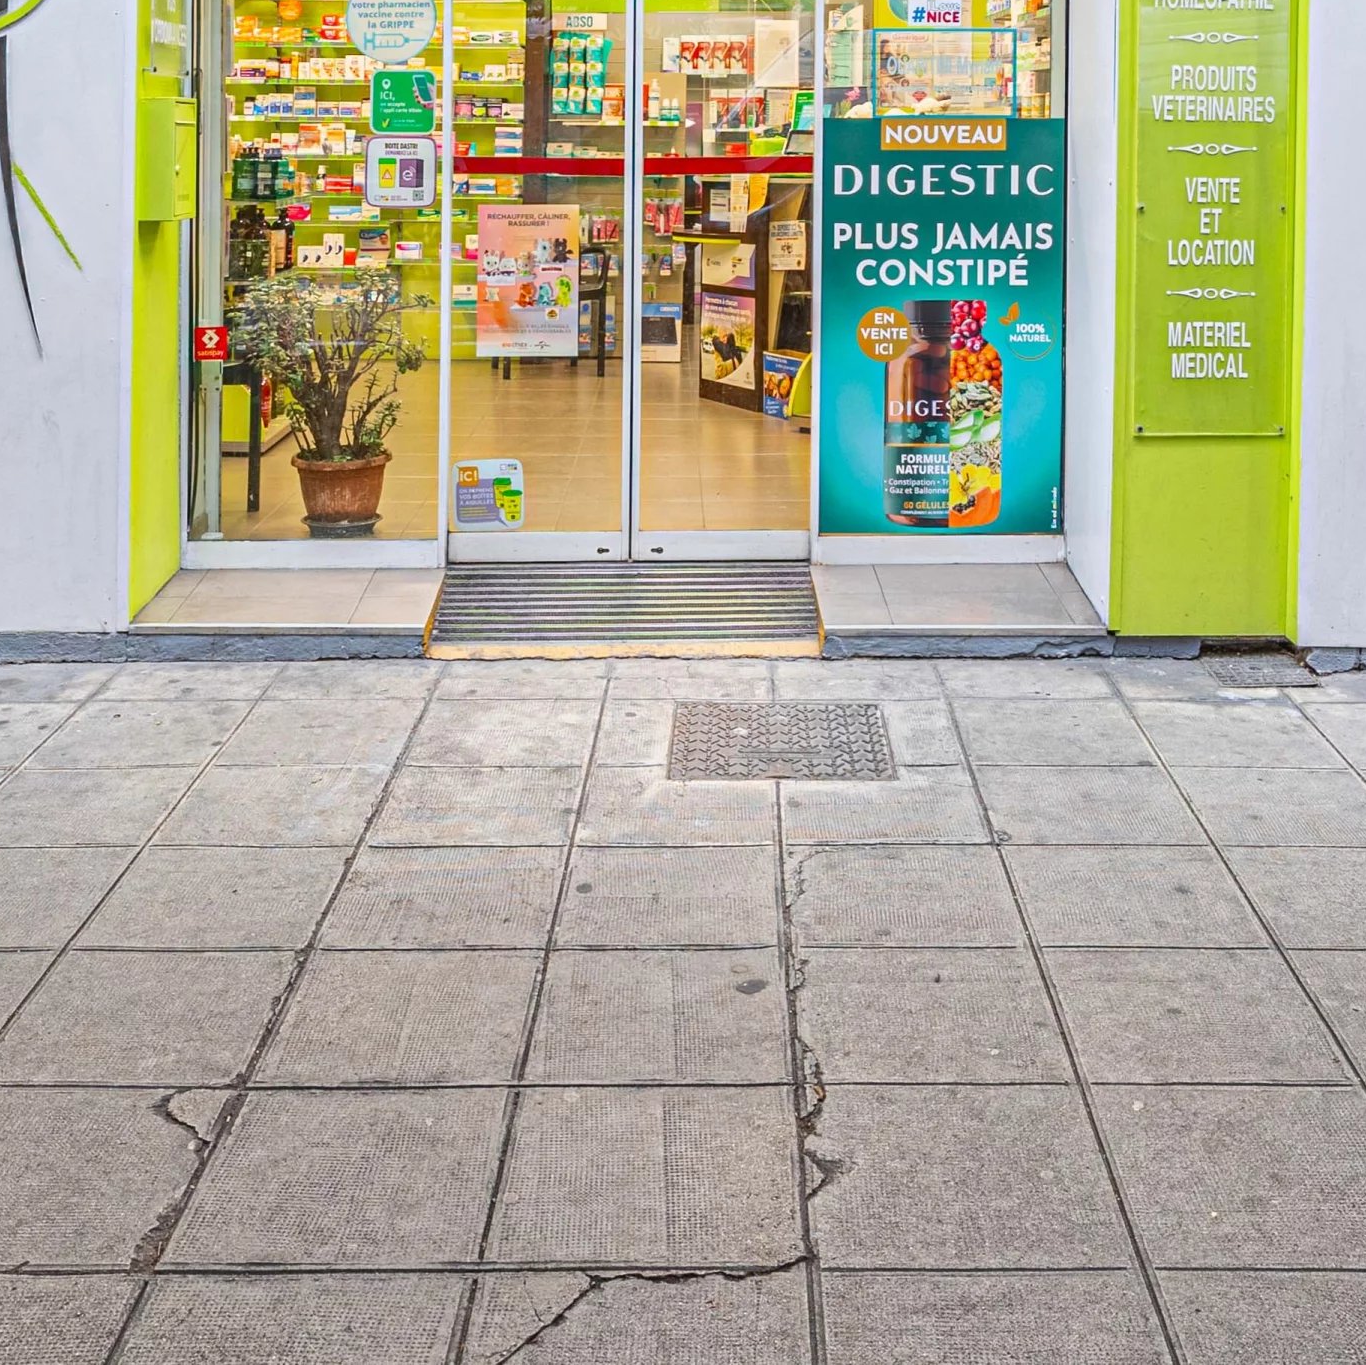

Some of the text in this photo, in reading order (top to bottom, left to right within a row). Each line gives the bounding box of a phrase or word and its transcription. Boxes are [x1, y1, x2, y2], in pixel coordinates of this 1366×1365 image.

[378, 1, 430, 11] pharmacien
[1171, 65, 1257, 92] PRODUITS
[1152, 95, 1275, 123] VETERINAIRES
[885, 125, 1003, 145] NOUVEAU
[834, 164, 1055, 196] DIGESTIC
[1186, 177, 1240, 204] VENTE
[1200, 208, 1222, 234] ET
[833, 222, 1053, 255] PLUS JAMAIS
[1168, 240, 1254, 266] LOCATION
[855, 252, 1029, 287] CONSTIPÉ
[874, 313, 894, 325] EN
[1015, 323, 1045, 334] 100%
[860, 327, 908, 340] VENTE
[1009, 333, 1051, 343] NATUREL
[1168, 321, 1251, 347] MATERIEL
[875, 342, 893, 355] ICI
[1171, 353, 1248, 378] MEDICAL
[888, 478, 935, 487] Constipation
[889, 487, 903, 495] Gaz
